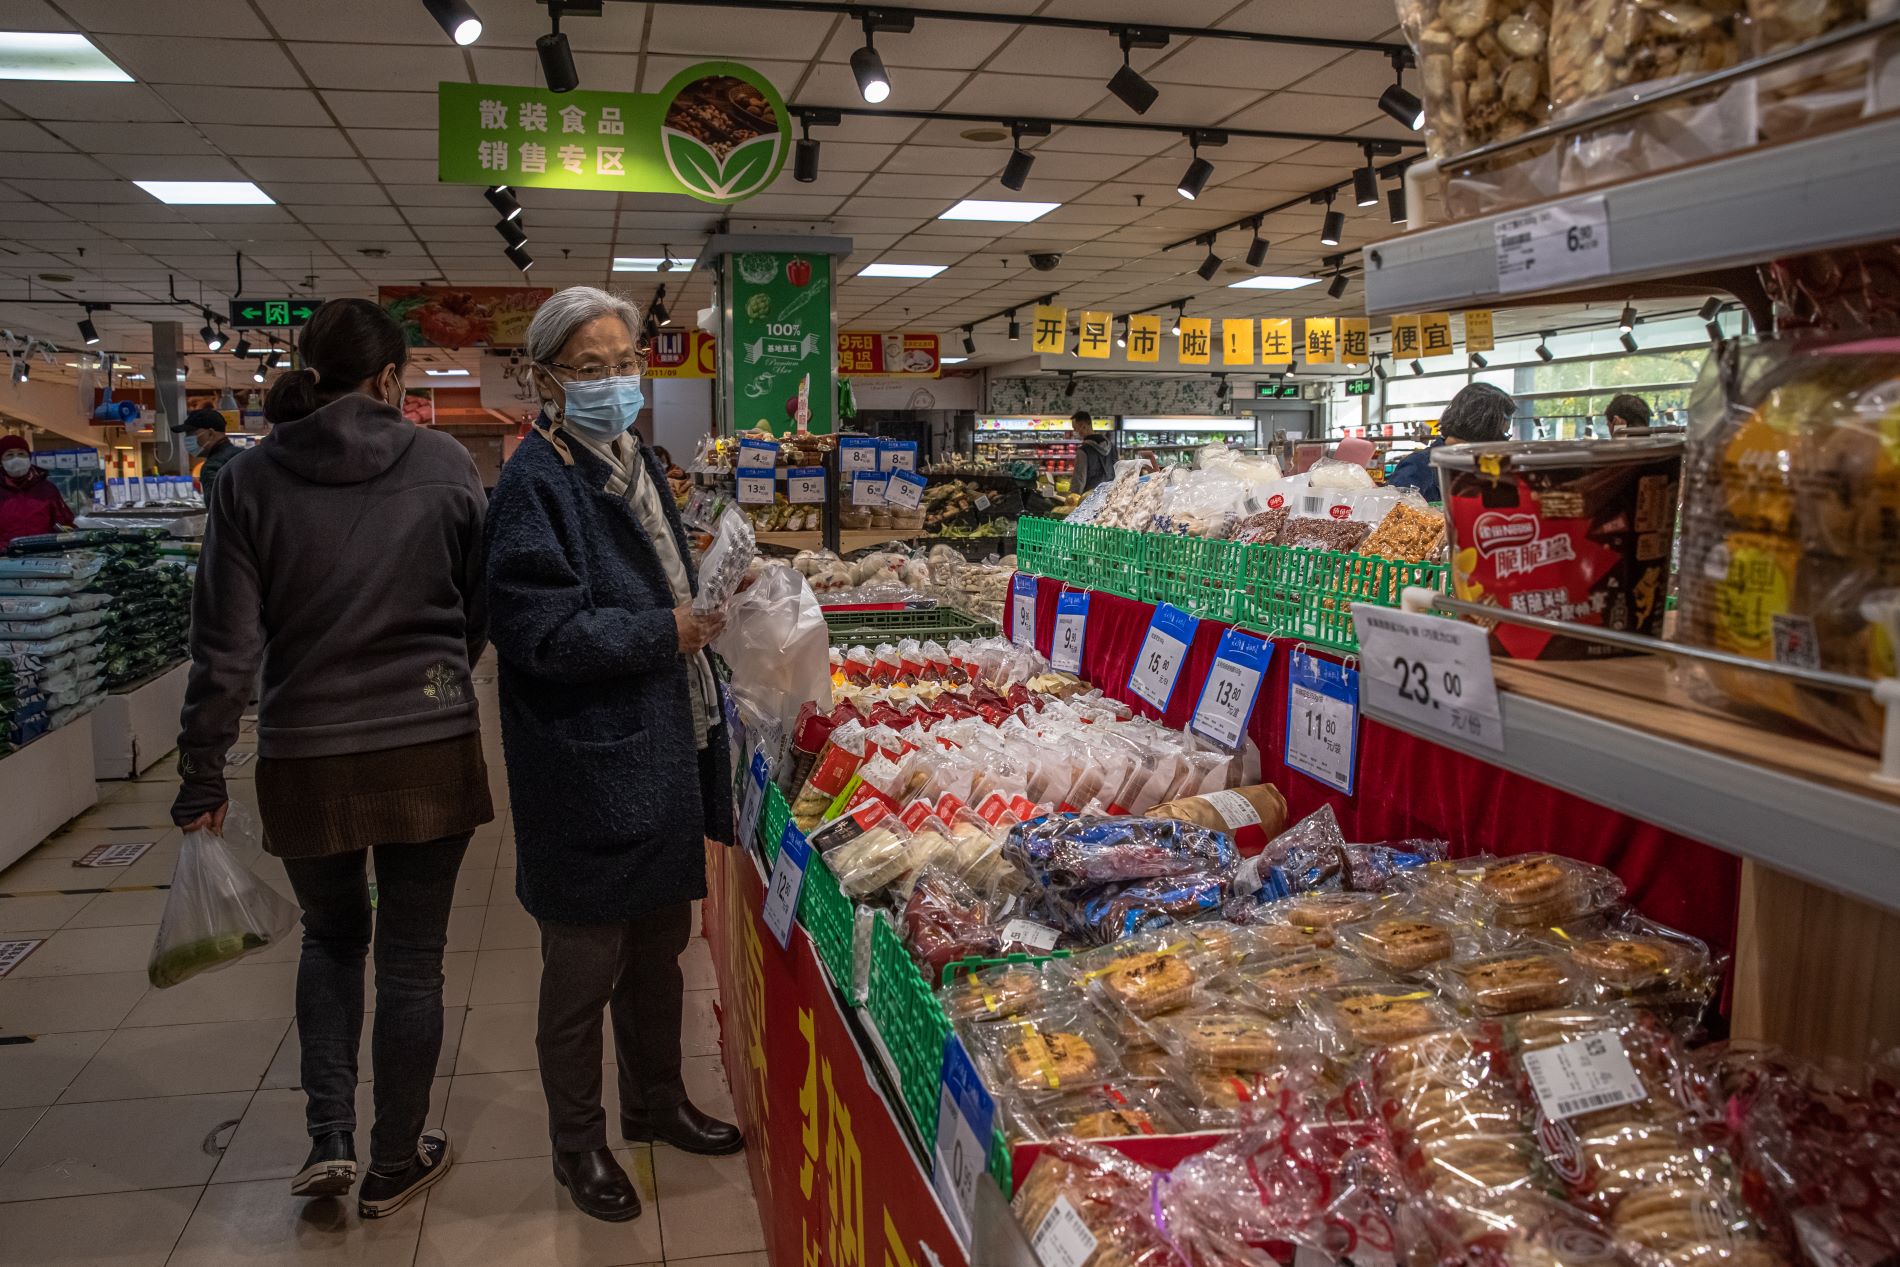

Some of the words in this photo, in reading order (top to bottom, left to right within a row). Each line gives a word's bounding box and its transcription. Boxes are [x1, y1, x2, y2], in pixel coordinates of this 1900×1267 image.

[479, 100, 624, 135] 散装食品
[478, 140, 625, 176] 销售专区
[766, 323, 801, 336] 100%
[1215, 679, 1241, 708] 13.80
[1393, 656, 1462, 710] 23.00
[1305, 709, 1336, 743] 11.80
